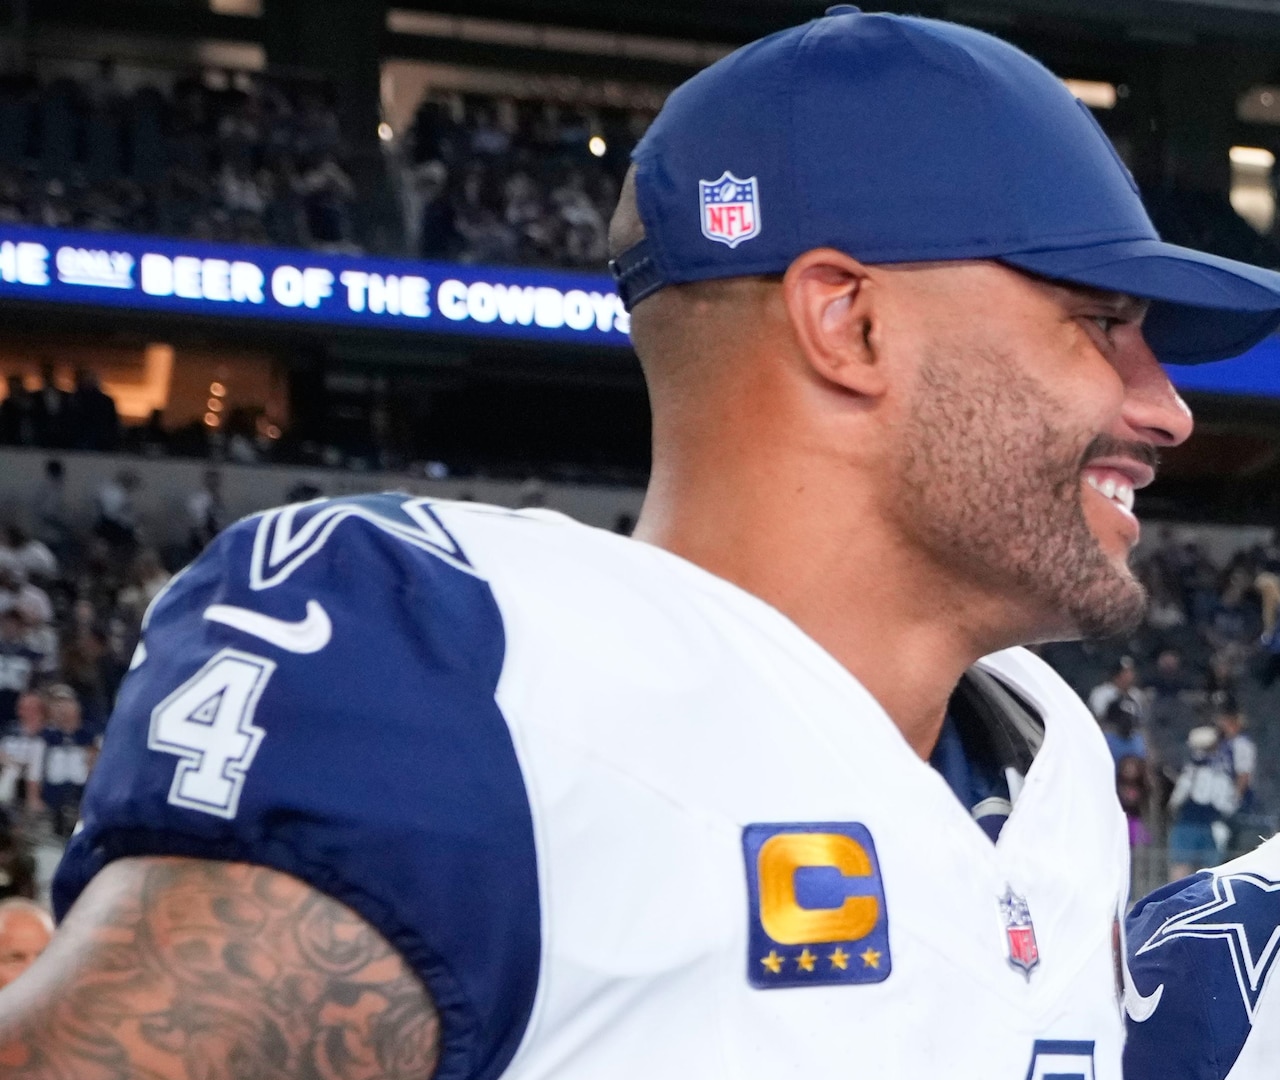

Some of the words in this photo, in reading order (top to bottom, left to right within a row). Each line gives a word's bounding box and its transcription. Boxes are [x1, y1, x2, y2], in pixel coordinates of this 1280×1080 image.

[708, 206, 751, 236] NFL
[0, 241, 48, 285] HE
[141, 253, 264, 304] BEER
[272, 265, 333, 308] OF
[340, 270, 430, 317] THE
[147, 647, 277, 820] 4
[758, 833, 879, 945] C
